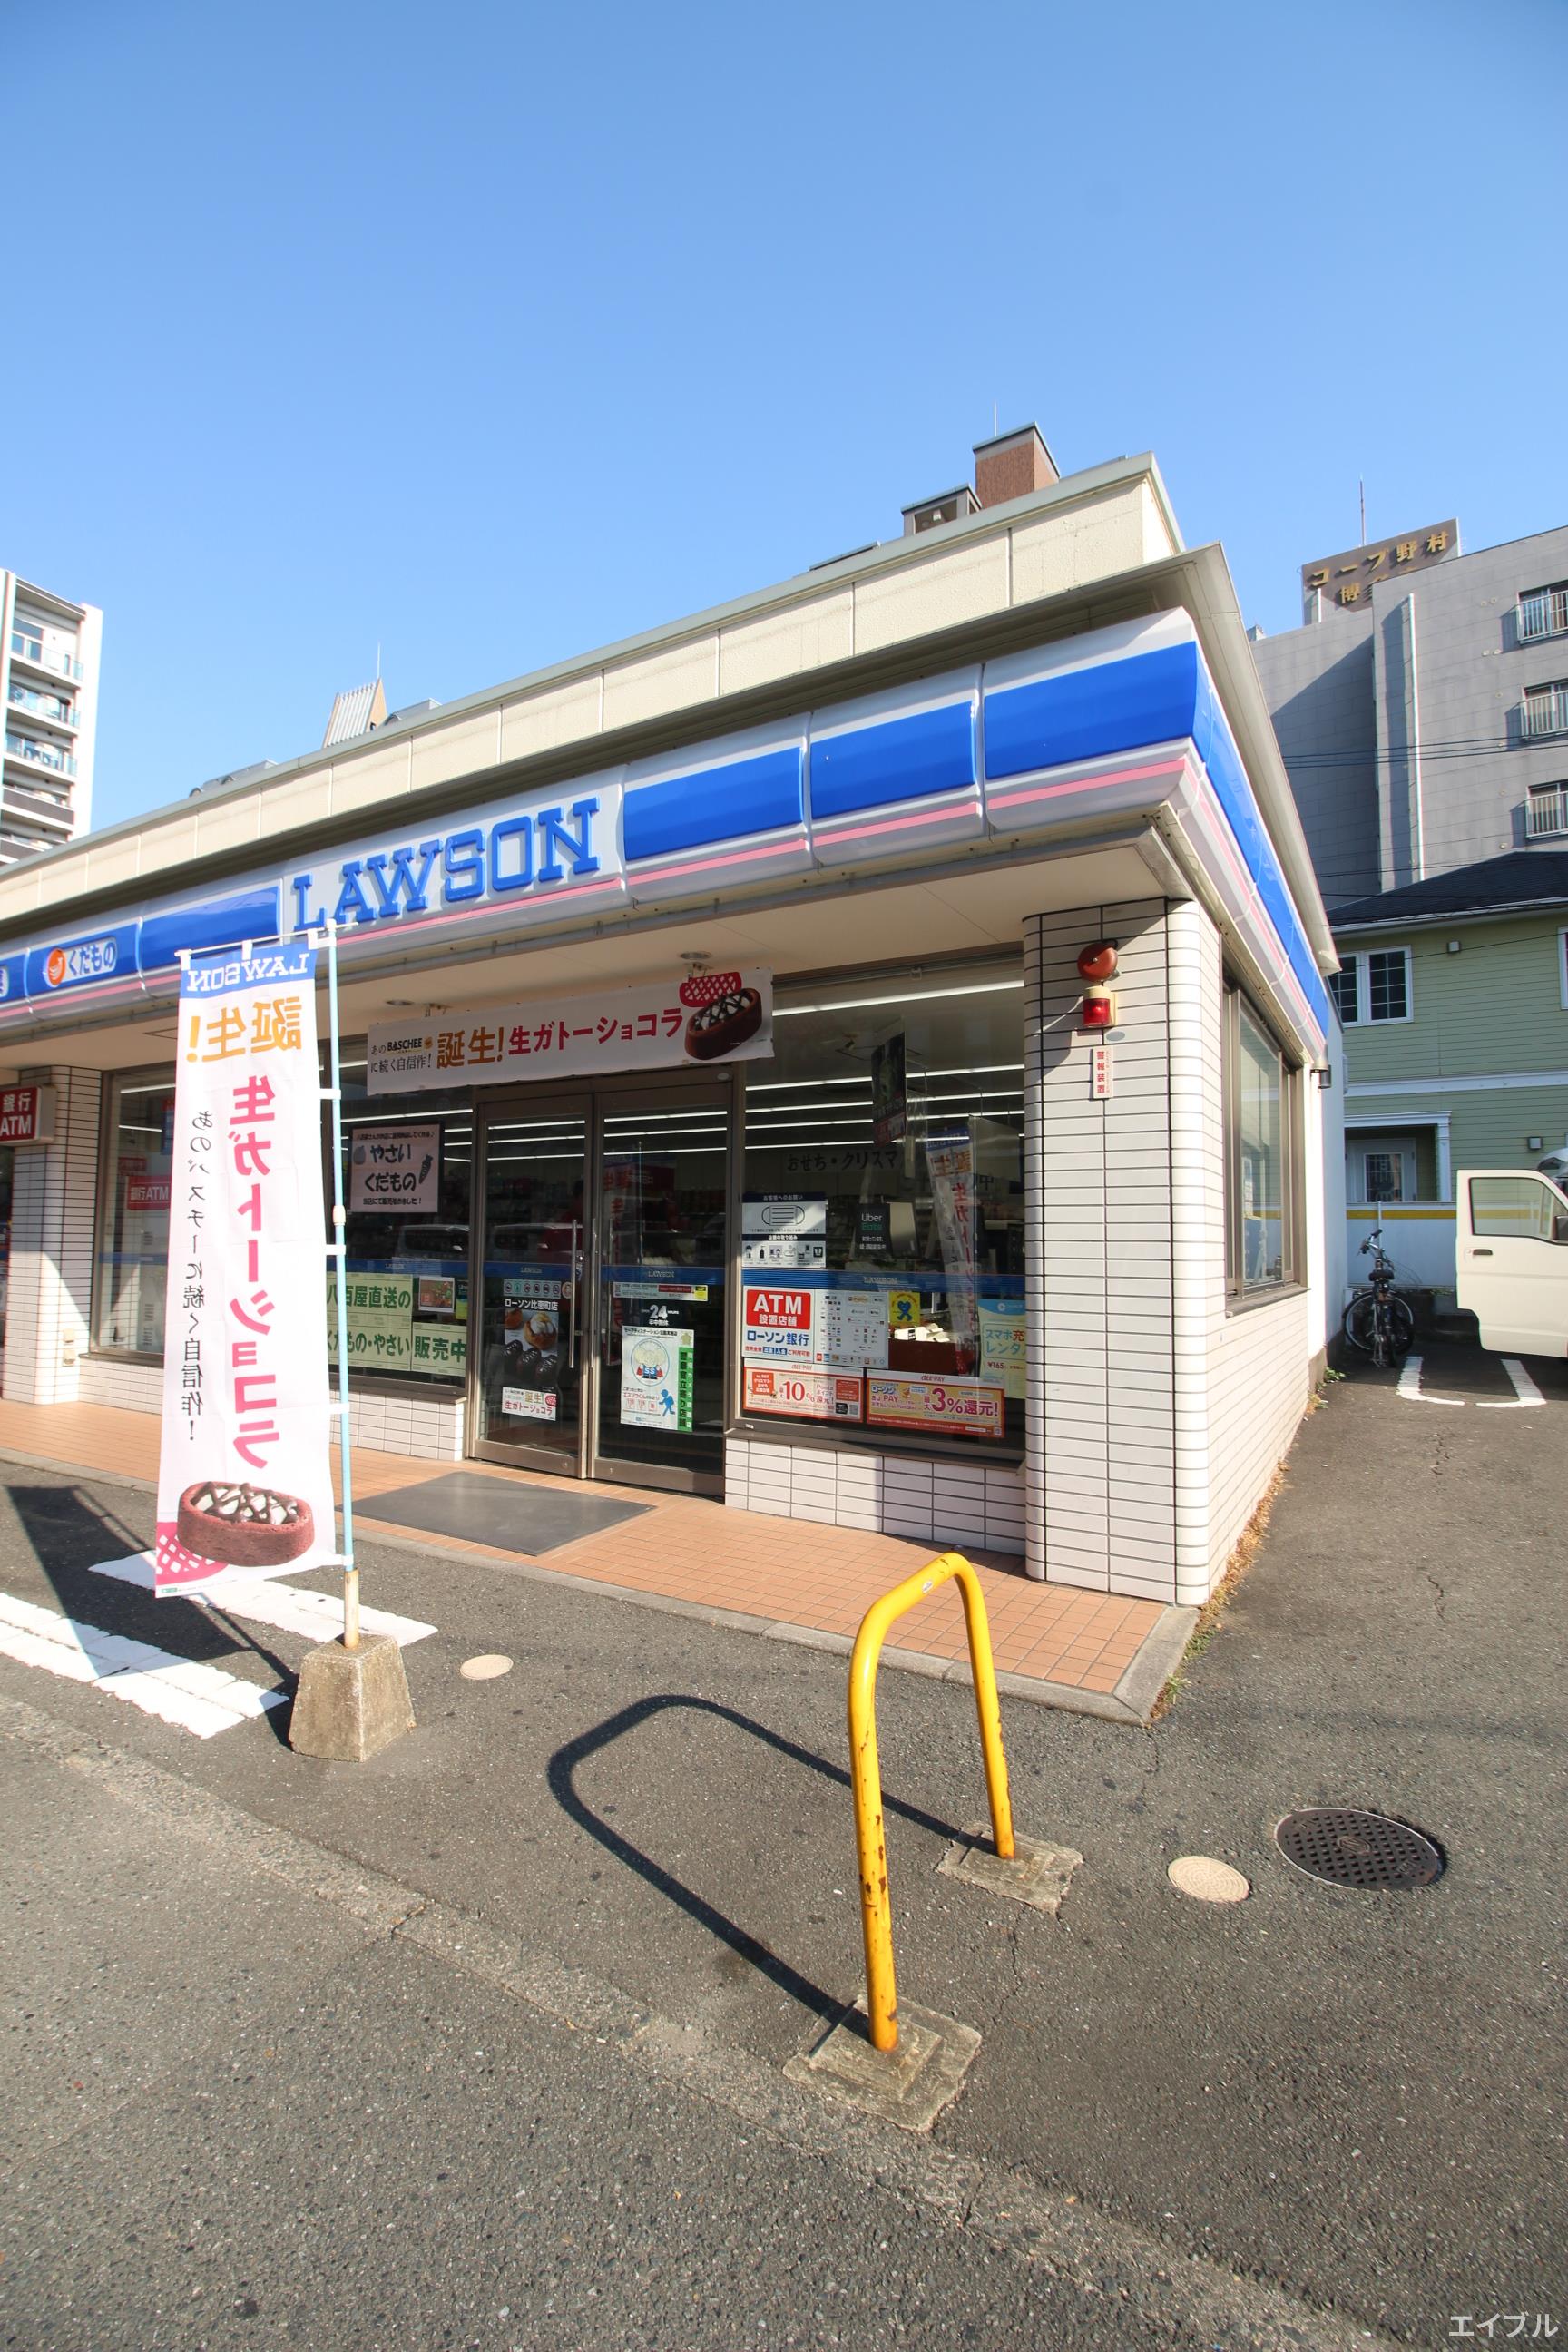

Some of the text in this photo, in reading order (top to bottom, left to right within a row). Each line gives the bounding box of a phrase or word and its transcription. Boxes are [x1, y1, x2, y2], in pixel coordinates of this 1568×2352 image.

[293, 797, 601, 931] LAWSON
[68, 941, 116, 976] くだもの
[508, 1008, 683, 1055] 生ガトーショコラ
[3, 1092, 32, 1112] 銀行
[0, 1115, 32, 1135] ATM
[370, 1144, 411, 1163] やさい
[365, 1172, 416, 1192] くだもの
[862, 1213, 882, 1222] Uber
[650, 1305, 669, 1319] 24
[753, 1294, 802, 1315] ATM
[747, 1329, 810, 1347] ローソン銀行
[414, 1336, 466, 1362] 販売中
